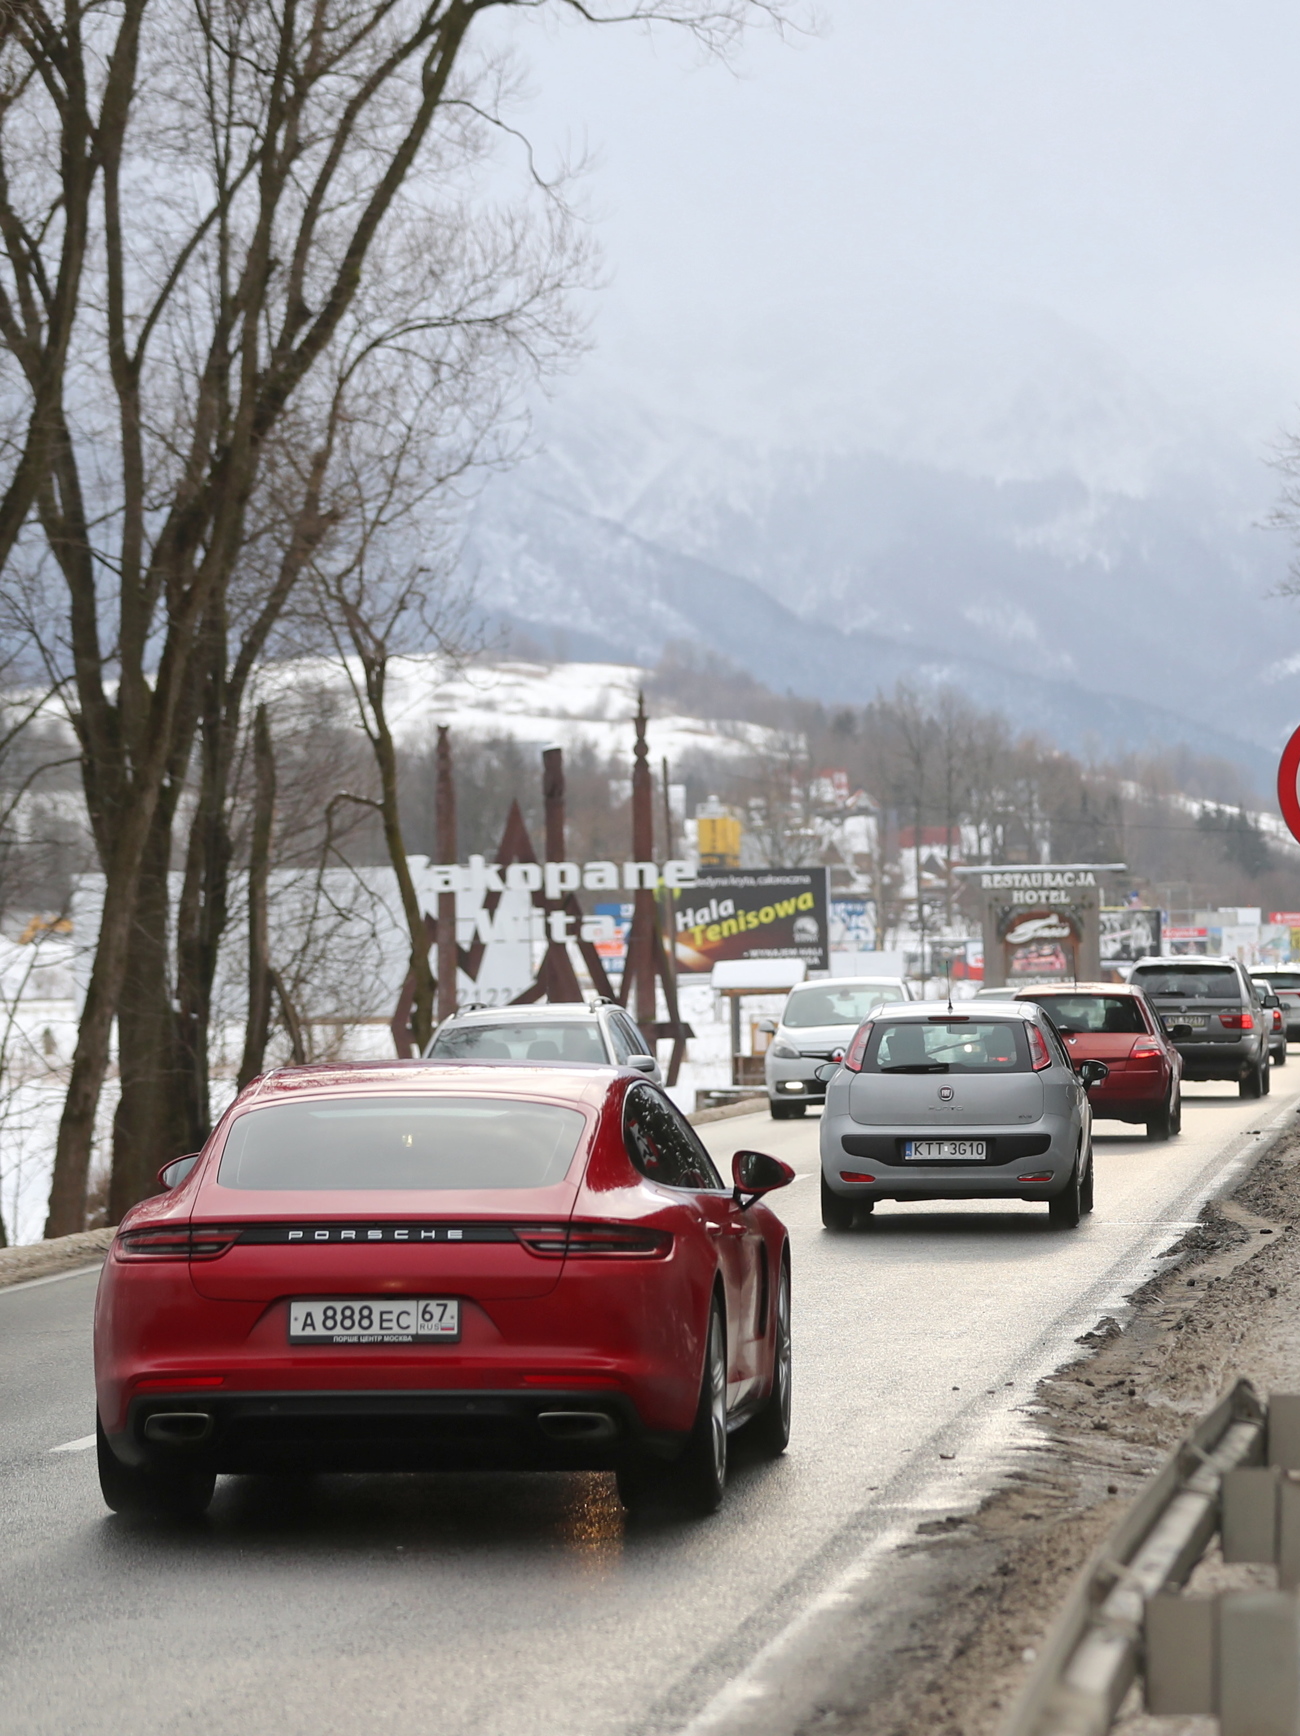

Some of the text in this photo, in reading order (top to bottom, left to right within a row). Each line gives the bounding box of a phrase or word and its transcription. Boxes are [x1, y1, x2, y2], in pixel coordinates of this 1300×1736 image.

[981, 872, 1096, 889] RESTAURACJA
[1012, 890, 1071, 904] HOTEL
[675, 897, 736, 933] Hala
[688, 891, 815, 947] Tenisowa
[914, 1142, 944, 1156] KTT
[949, 1142, 984, 1156] 3G10
[288, 1230, 463, 1241] PORSCHE
[421, 1303, 448, 1323] 67
[419, 1323, 440, 1331] RUS
[333, 1335, 412, 1343] ПОРШЕ ЦЕНТР МОСКВА
